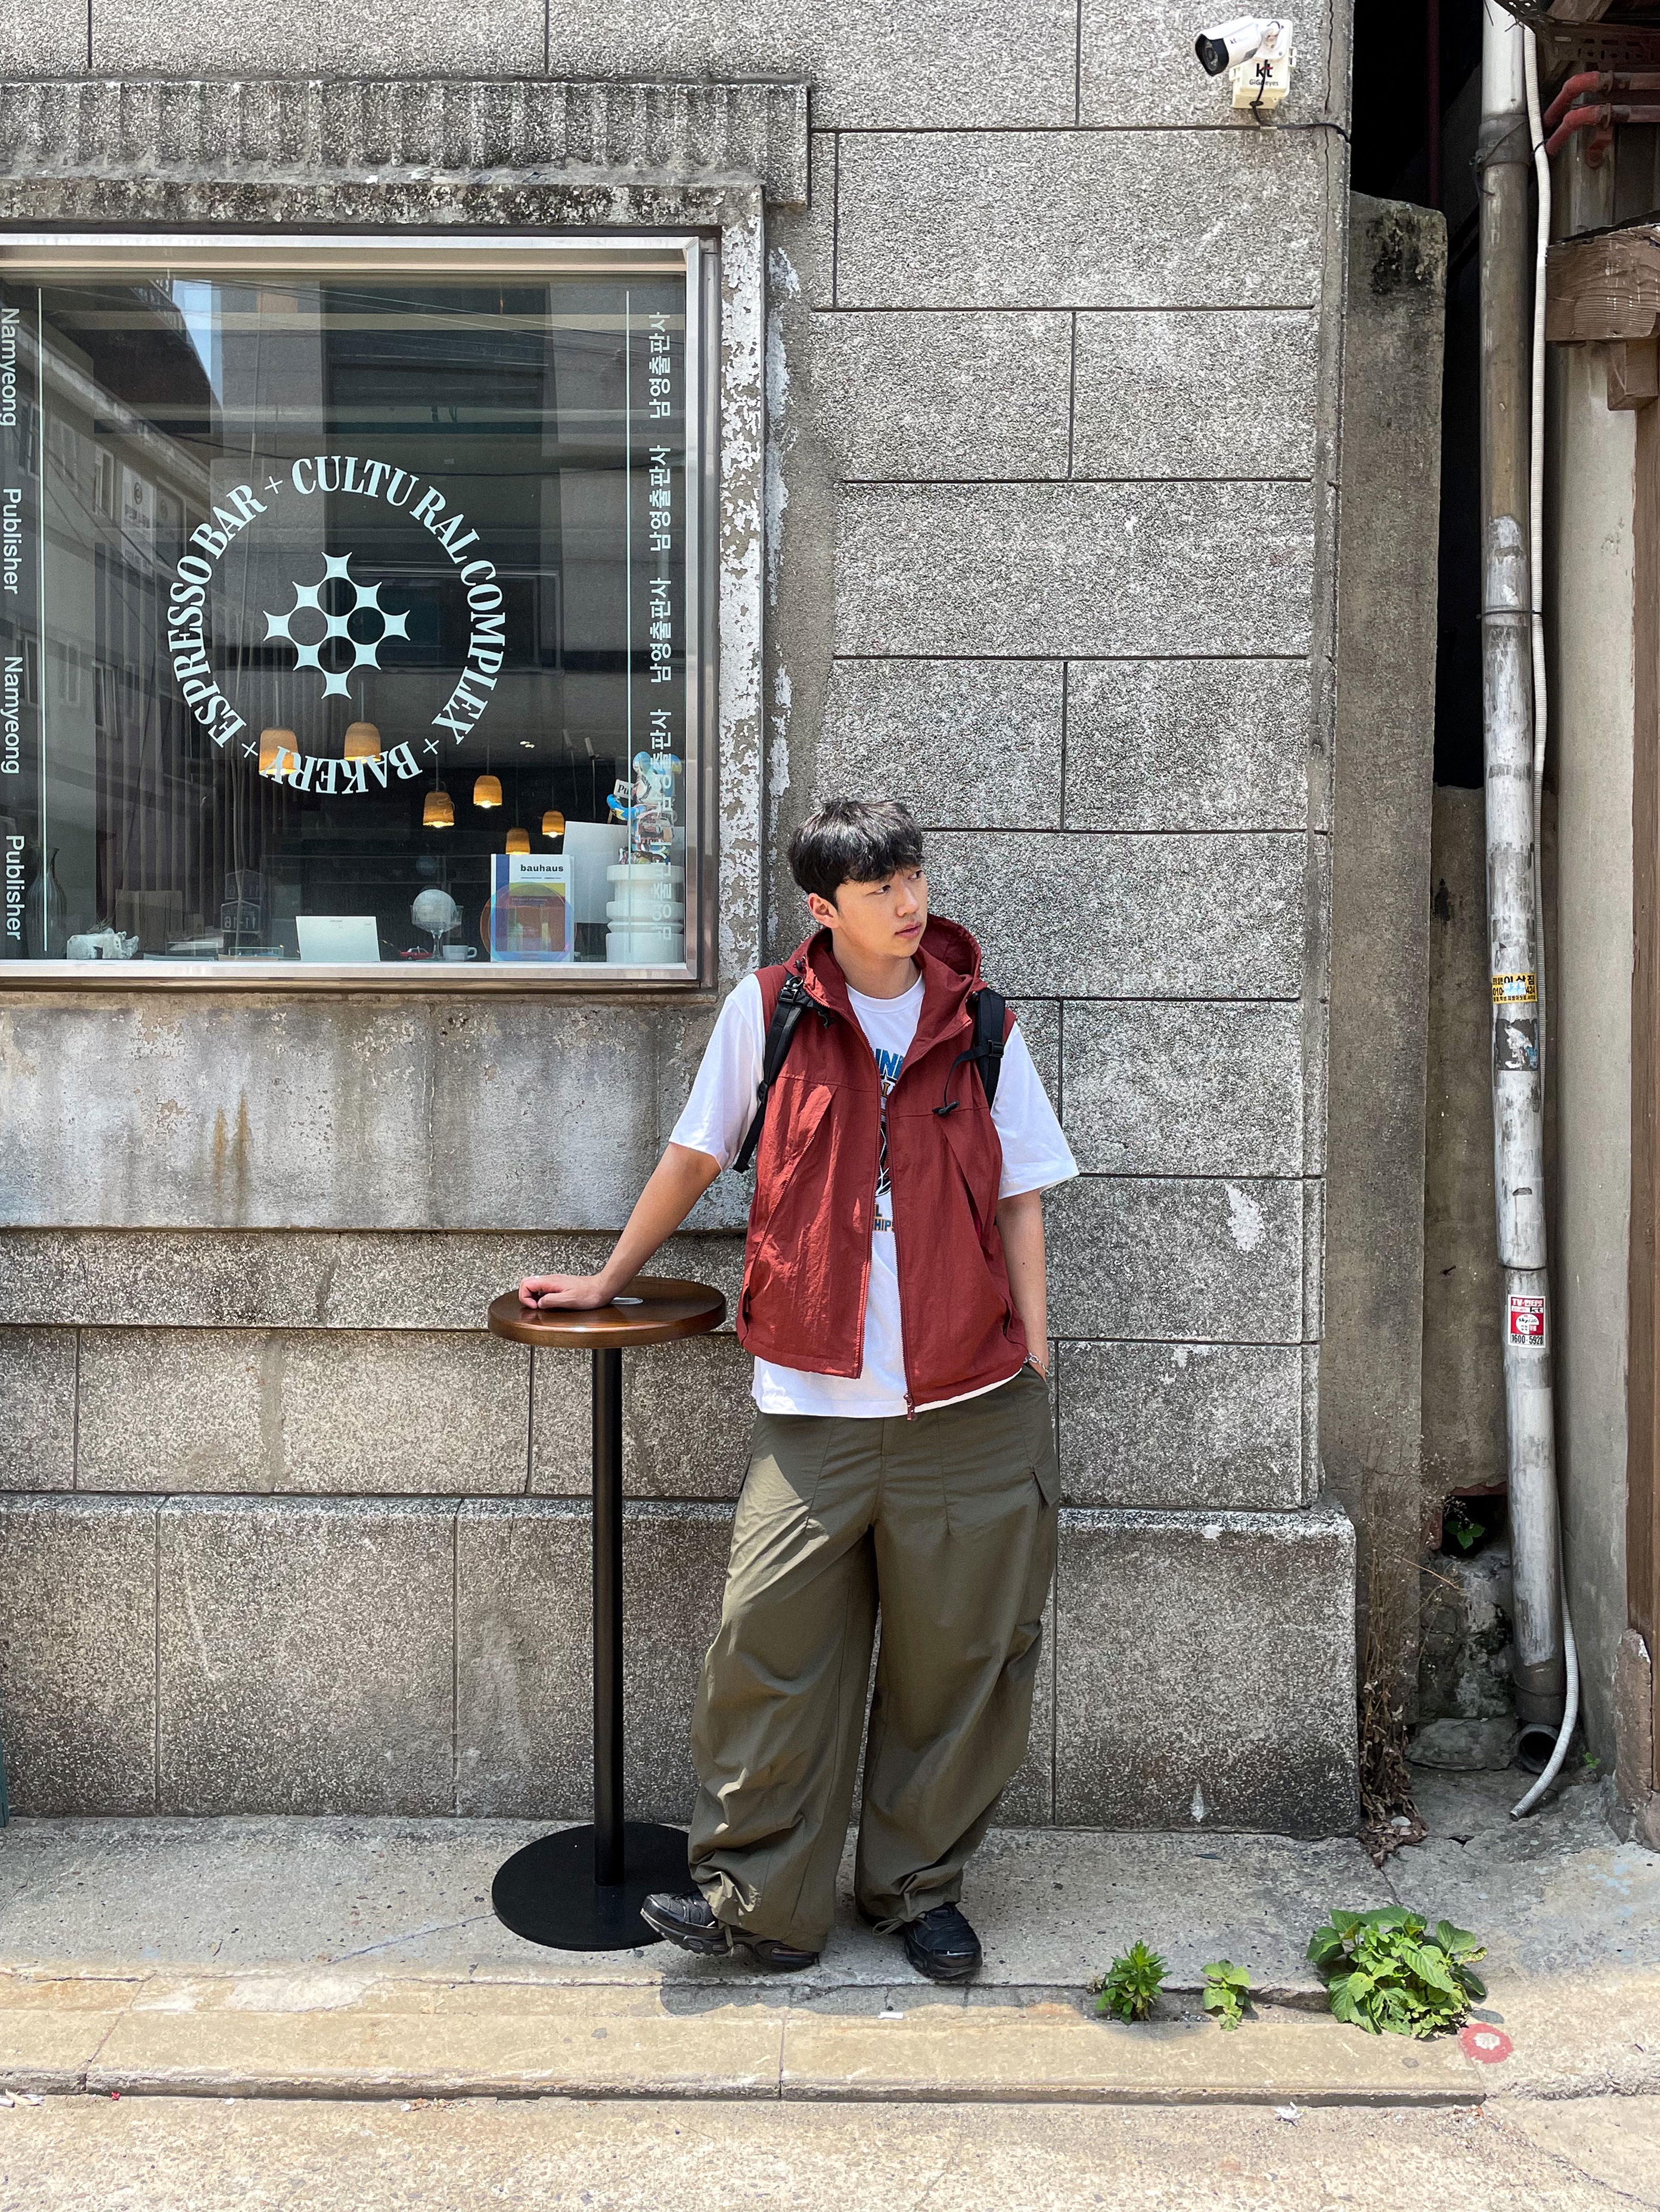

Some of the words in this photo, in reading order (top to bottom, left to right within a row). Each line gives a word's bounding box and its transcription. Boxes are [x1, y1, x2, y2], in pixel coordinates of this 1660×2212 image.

[1256, 63, 1273, 77] kt
[0, 308, 20, 426] Namyeong
[649, 312, 671, 419] 남영출판사
[2, 488, 23, 595] Publisher
[189, 484, 268, 560] BAR
[291, 455, 480, 564] CULTURAL
[649, 445, 672, 552] 남영출판사
[167, 555, 247, 748] ESPRESSO
[431, 560, 505, 745] COMPLEX
[650, 577, 672, 684] 남영출판사
[1, 656, 23, 775] Namyeong
[259, 741, 423, 794] BAKERY
[650, 709, 672, 812] 남영출판사
[5, 835, 25, 940] Publisher
